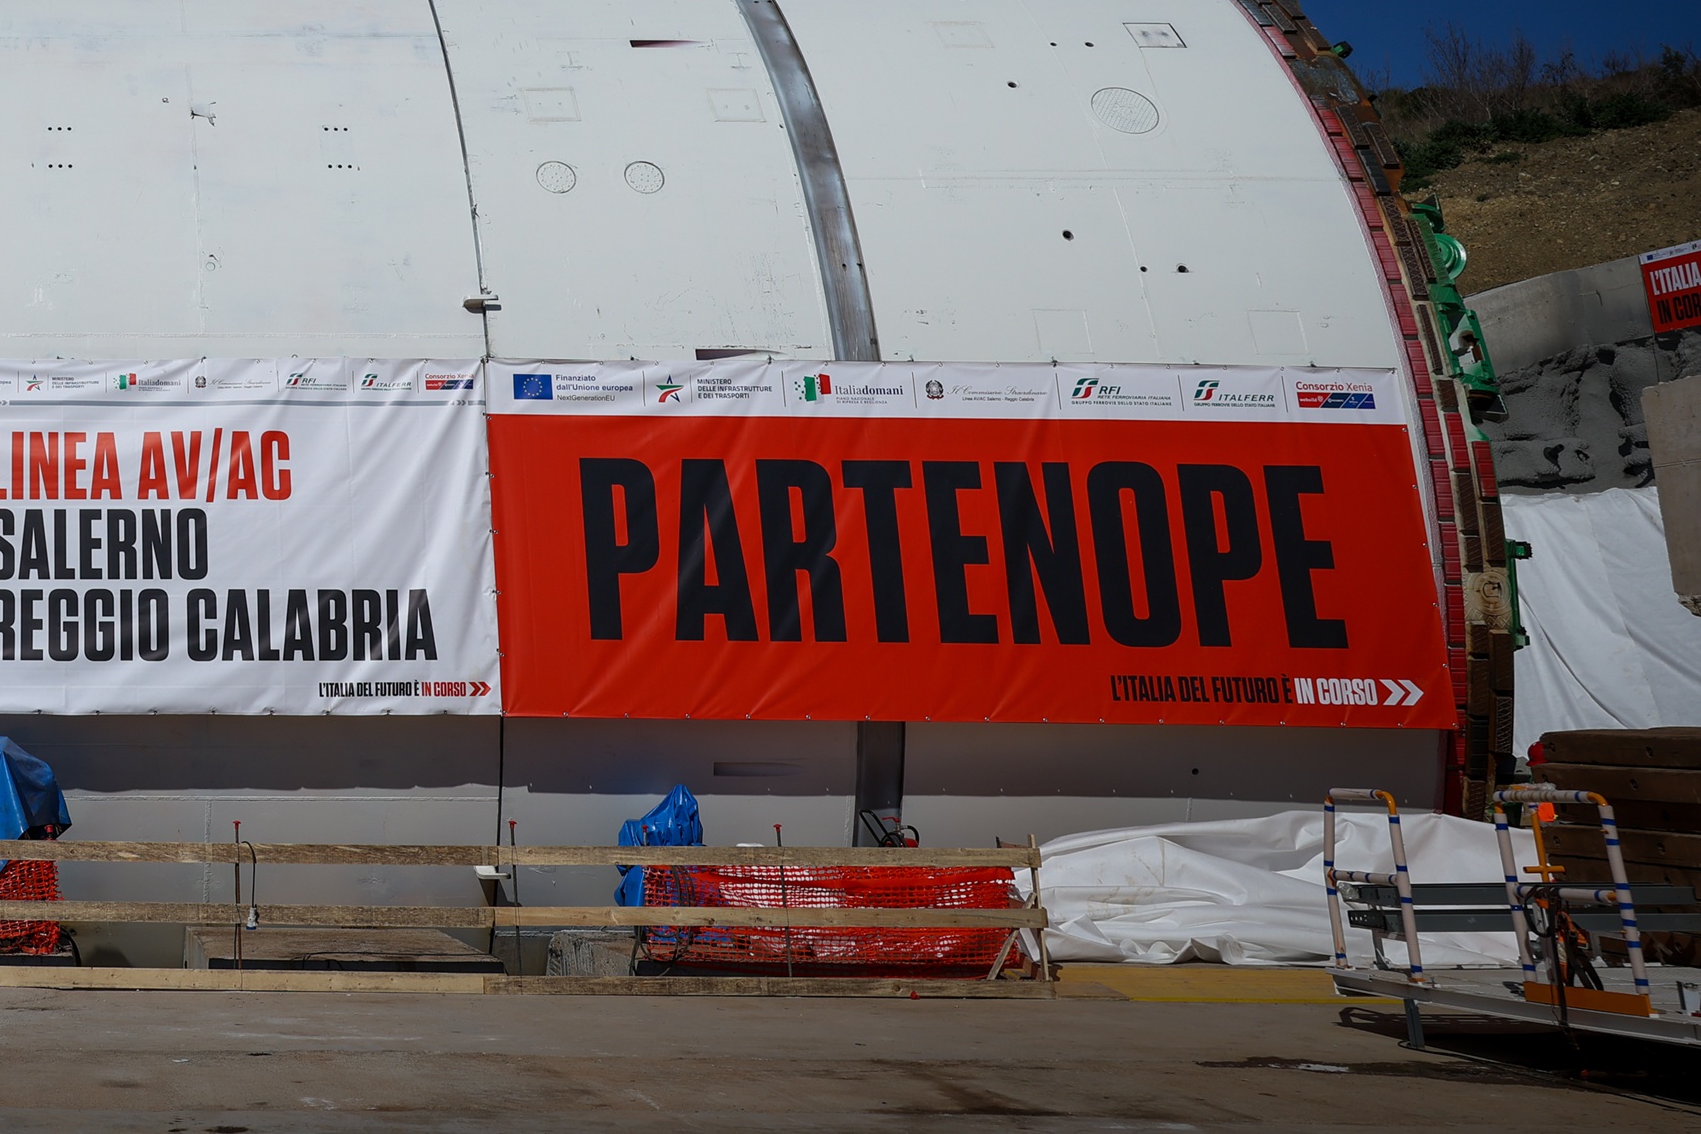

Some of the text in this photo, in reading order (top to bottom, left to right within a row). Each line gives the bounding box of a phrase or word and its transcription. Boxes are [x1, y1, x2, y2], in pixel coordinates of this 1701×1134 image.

[1649, 261, 1701, 296] L'ITALIA
[1656, 298, 1673, 324] IN
[555, 374, 596, 382] Finanziato
[556, 383, 633, 393] dall'Unione europea
[835, 384, 904, 395] Italiadomani
[1099, 386, 1121, 395] RFI
[1295, 381, 1373, 392] Consorzio Xenia
[556, 394, 616, 402] NextGenerationEU
[1219, 394, 1274, 402] ITALFERR
[138, 427, 292, 503] AV/AC
[579, 457, 1350, 650] PARTENOPE
[186, 588, 438, 662] CALABRIA
[318, 679, 467, 698] L'ITALIA DEL FUTURO È IN CORSO
[1110, 673, 1379, 706] L'ITALIA DEL FUTURO È IN CORSO
